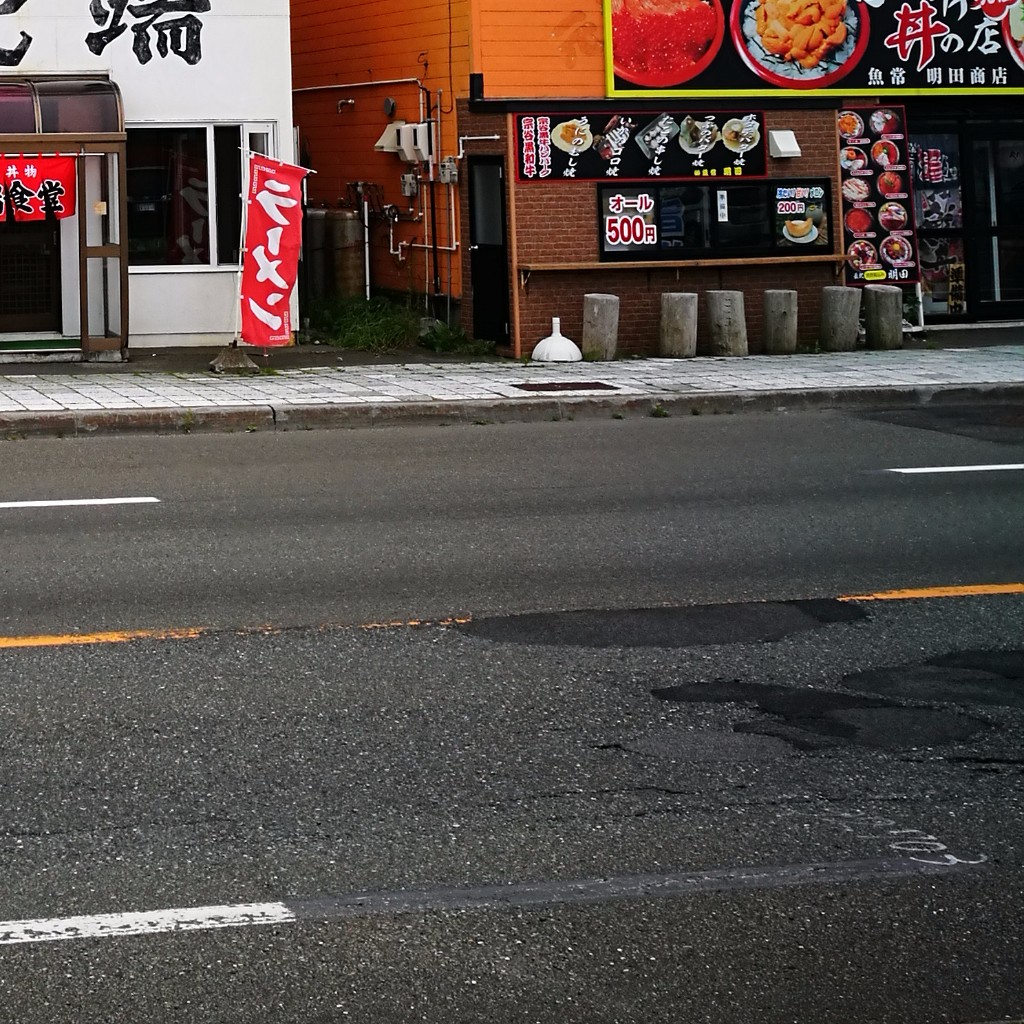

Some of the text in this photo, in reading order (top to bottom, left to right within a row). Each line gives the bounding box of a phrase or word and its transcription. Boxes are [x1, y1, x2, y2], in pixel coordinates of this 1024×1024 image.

[609, 194, 654, 213] オール
[777, 201, 805, 214] 200円
[606, 216, 657, 245] 500円
[249, 179, 298, 331] ラーメン
